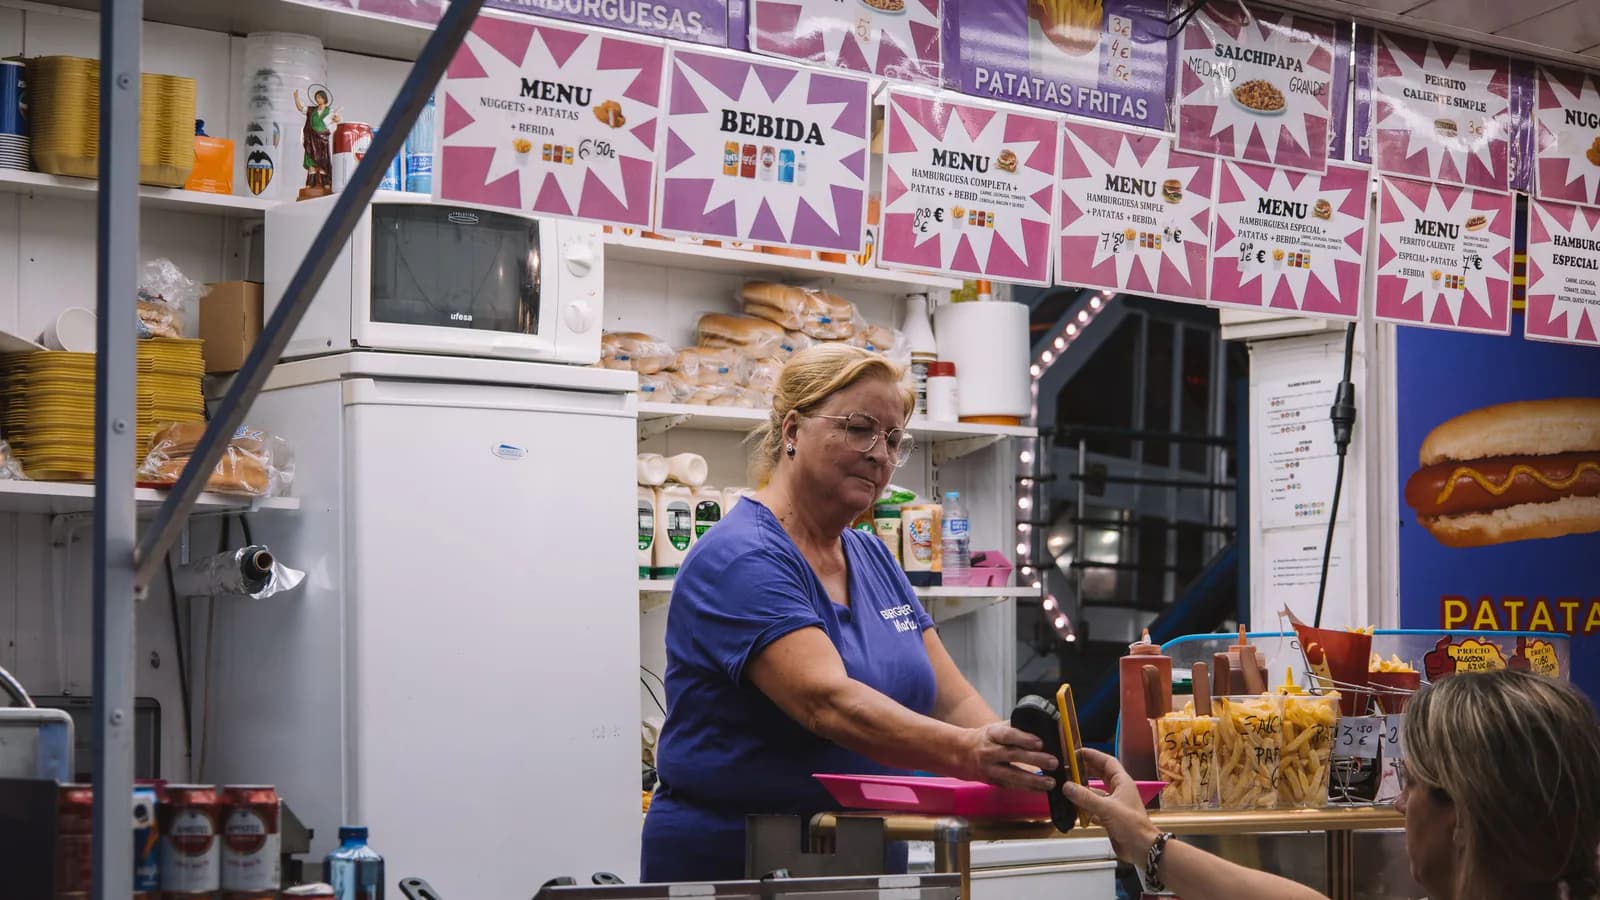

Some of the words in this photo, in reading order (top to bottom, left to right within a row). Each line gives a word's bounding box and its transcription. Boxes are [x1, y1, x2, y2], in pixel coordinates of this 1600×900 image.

[504, 0, 703, 35] BURGUESAS
[1215, 44, 1304, 73] SALCHIPAPA
[520, 77, 592, 107] MENU
[1289, 76, 1326, 96] GRANDE
[1425, 74, 1466, 91] PERRITO
[975, 67, 1072, 106] PATATAS
[1077, 87, 1148, 120] FRITAS
[1403, 88, 1452, 105] CALIENTE
[1453, 97, 1487, 113] SIMPLE
[480, 97, 525, 113] NUGGETS
[536, 105, 580, 121] PATATAS
[1565, 109, 1600, 130] NUG
[720, 109, 825, 146] BEBIDA
[932, 148, 990, 173] MENU
[911, 183, 945, 197] PATATAS
[912, 168, 969, 185] HAMBURGUESA
[970, 177, 1011, 192] COMPLETA
[1105, 174, 1157, 197] MENU
[1086, 192, 1139, 208] HAMBURGUESA
[1140, 201, 1164, 213] SIMPLE
[1257, 197, 1308, 219] MENU
[1092, 208, 1124, 220] PATATAS
[1132, 214, 1157, 225] BEBIDA
[1239, 216, 1289, 230] HAMBURGUESA
[1290, 223, 1320, 234] ESPECIAL
[1238, 229, 1268, 241] PATATAS
[1414, 219, 1460, 239] MENU
[1399, 236, 1426, 247] PERRITO
[1426, 240, 1455, 251] CALIENTE
[1430, 256, 1458, 267] PATATAS
[1552, 253, 1599, 270] ESPECIAL
[1403, 268, 1425, 278] BEBIDA
[450, 312, 473, 322] ufesa
[880, 604, 914, 620] BURGER
[1444, 600, 1600, 632] PATATA
